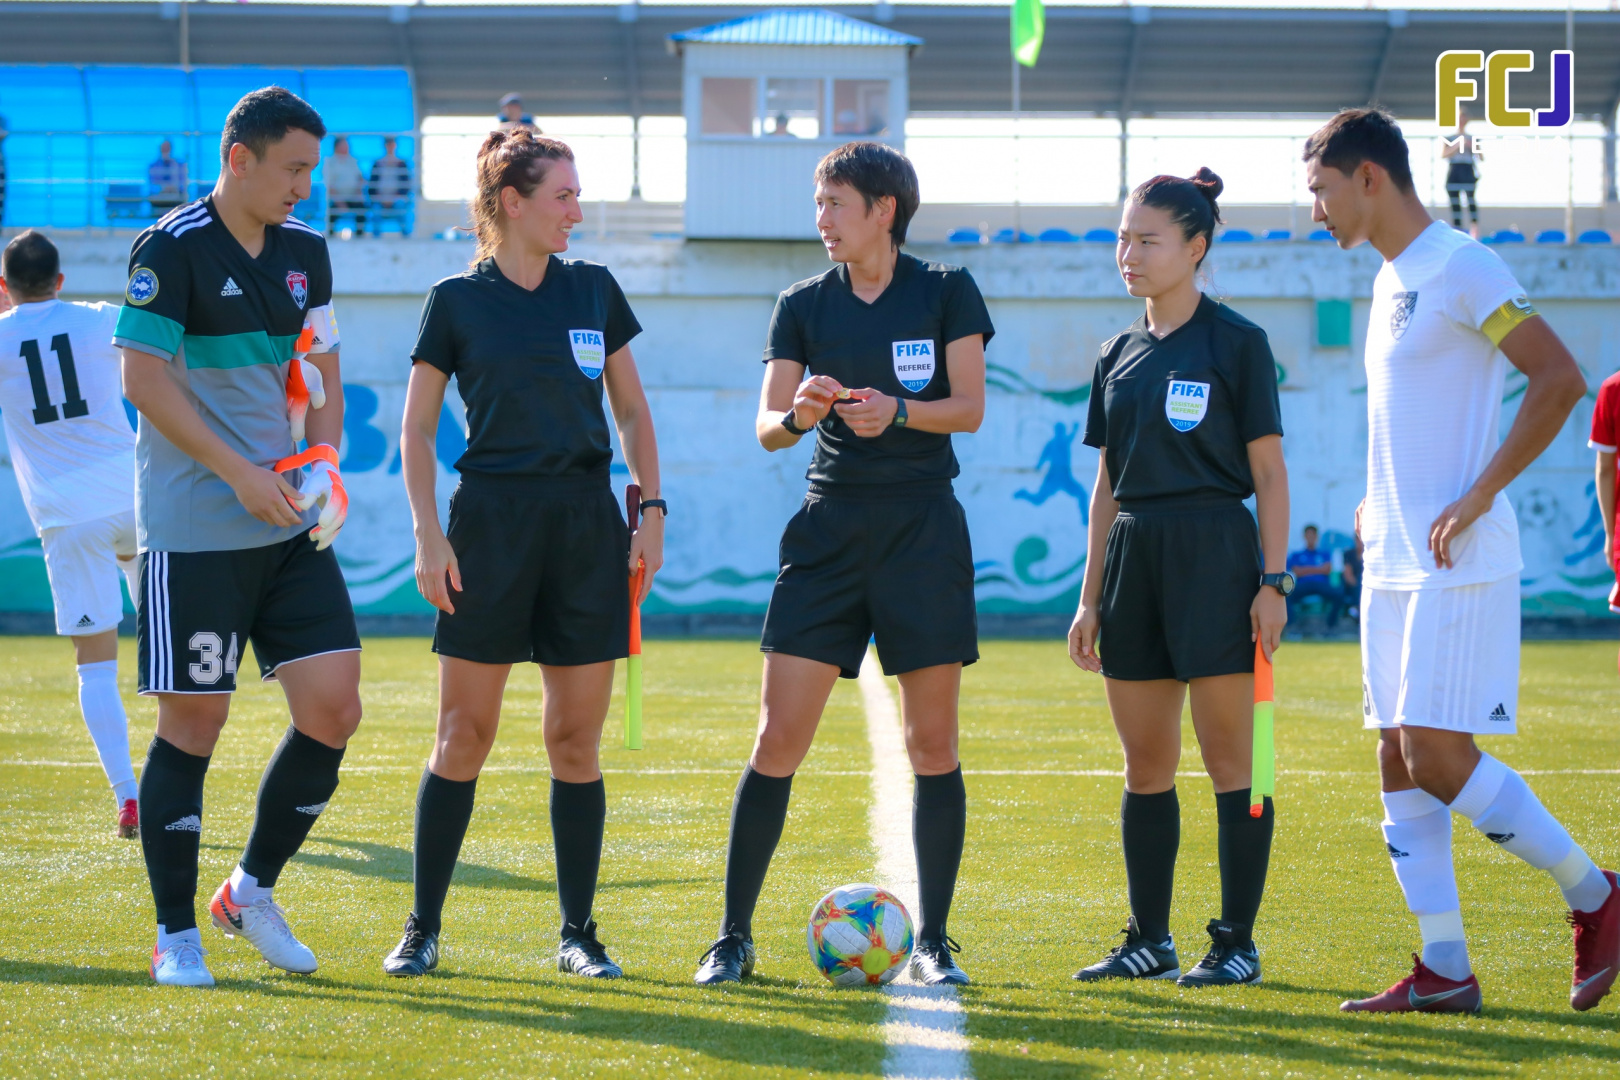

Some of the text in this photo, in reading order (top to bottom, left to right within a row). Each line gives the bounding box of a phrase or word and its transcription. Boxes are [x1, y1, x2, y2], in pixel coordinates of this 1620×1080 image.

[573, 333, 602, 346] FIFA
[896, 343, 931, 357] FIFA
[898, 363, 931, 372] REFEREE
[19, 333, 89, 425] 11
[1171, 383, 1204, 398] FIFA
[1170, 401, 1203, 409] ASSISTANT
[1171, 407, 1200, 415] REFEREE
[189, 632, 238, 685] 34
